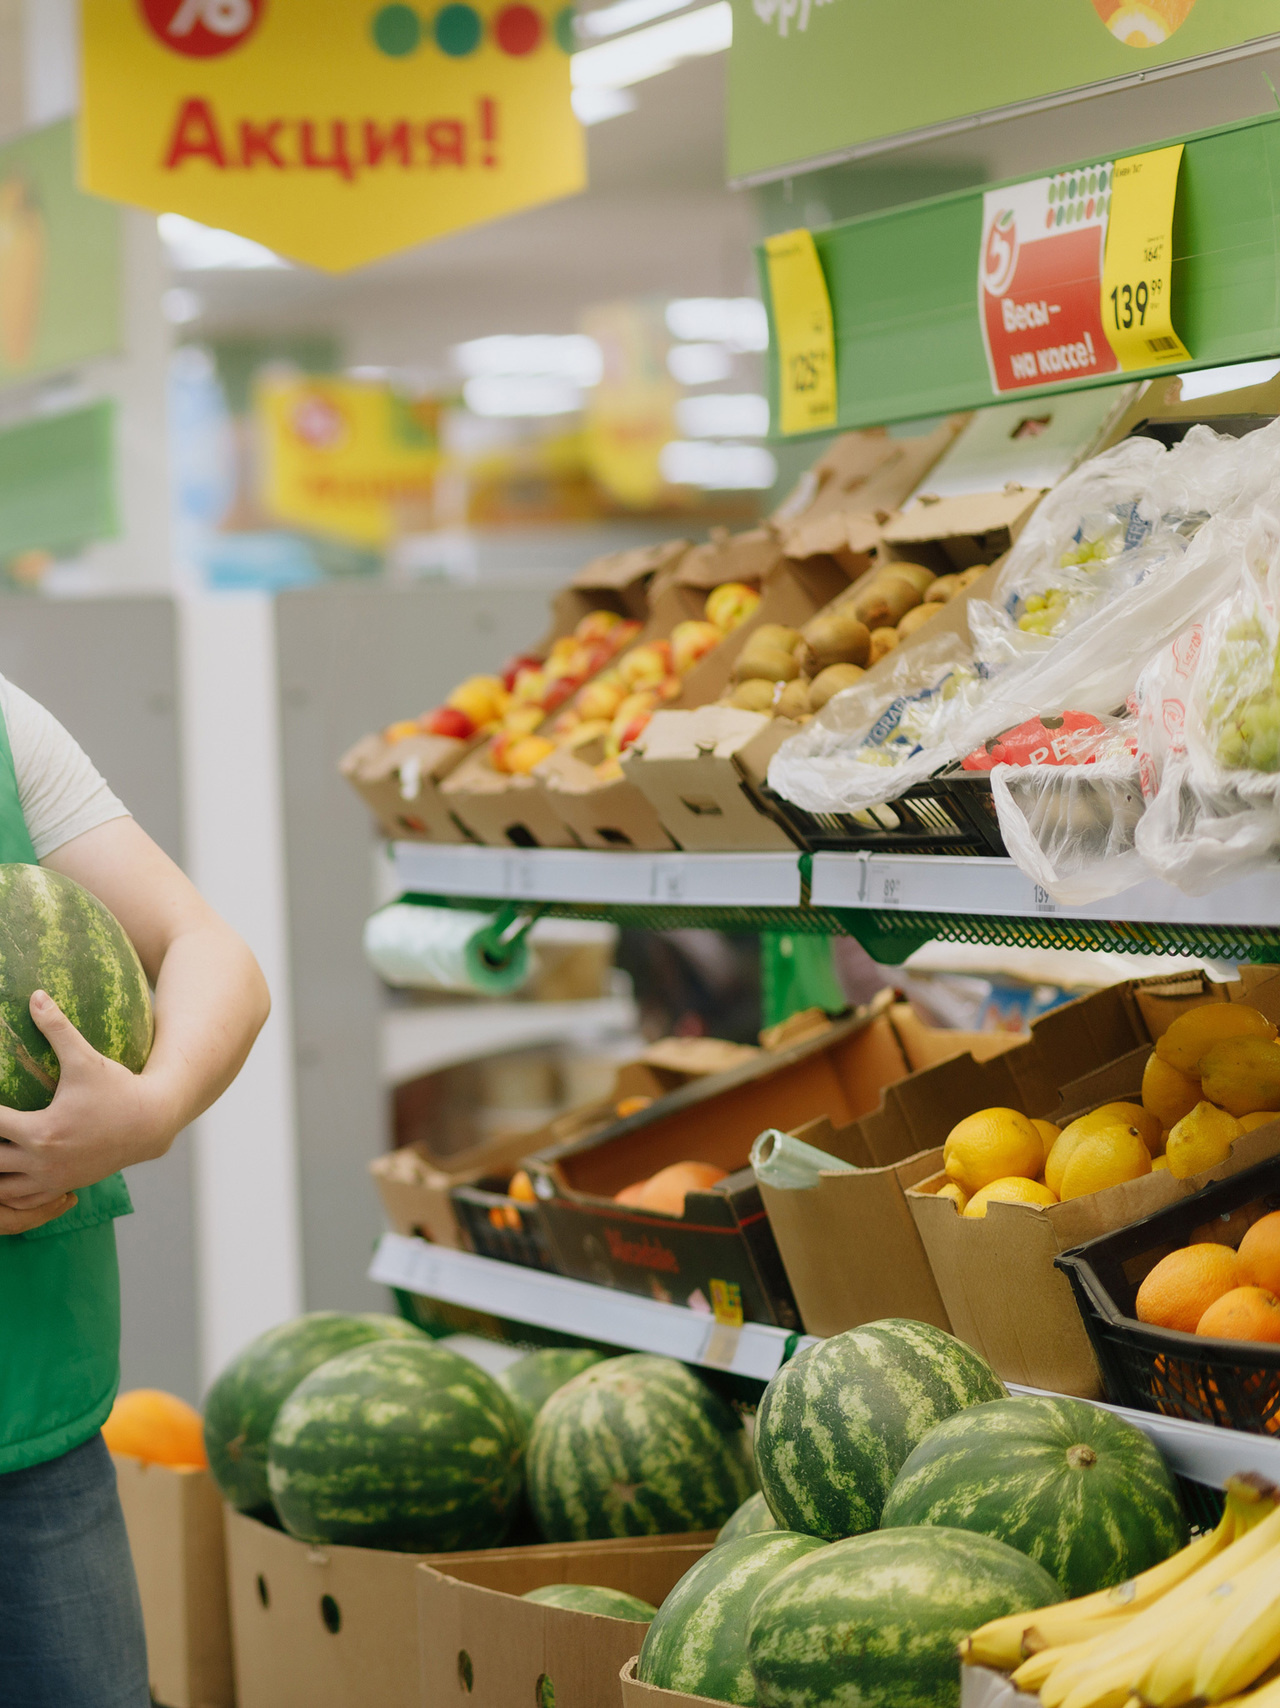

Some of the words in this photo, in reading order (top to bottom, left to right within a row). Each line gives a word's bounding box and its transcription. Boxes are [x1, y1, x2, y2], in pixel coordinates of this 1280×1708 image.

[161, 95, 499, 184] Акция!
[1111, 281, 1148, 330] 139
[1010, 351, 1038, 380] на
[1036, 331, 1096, 376] кассе!
